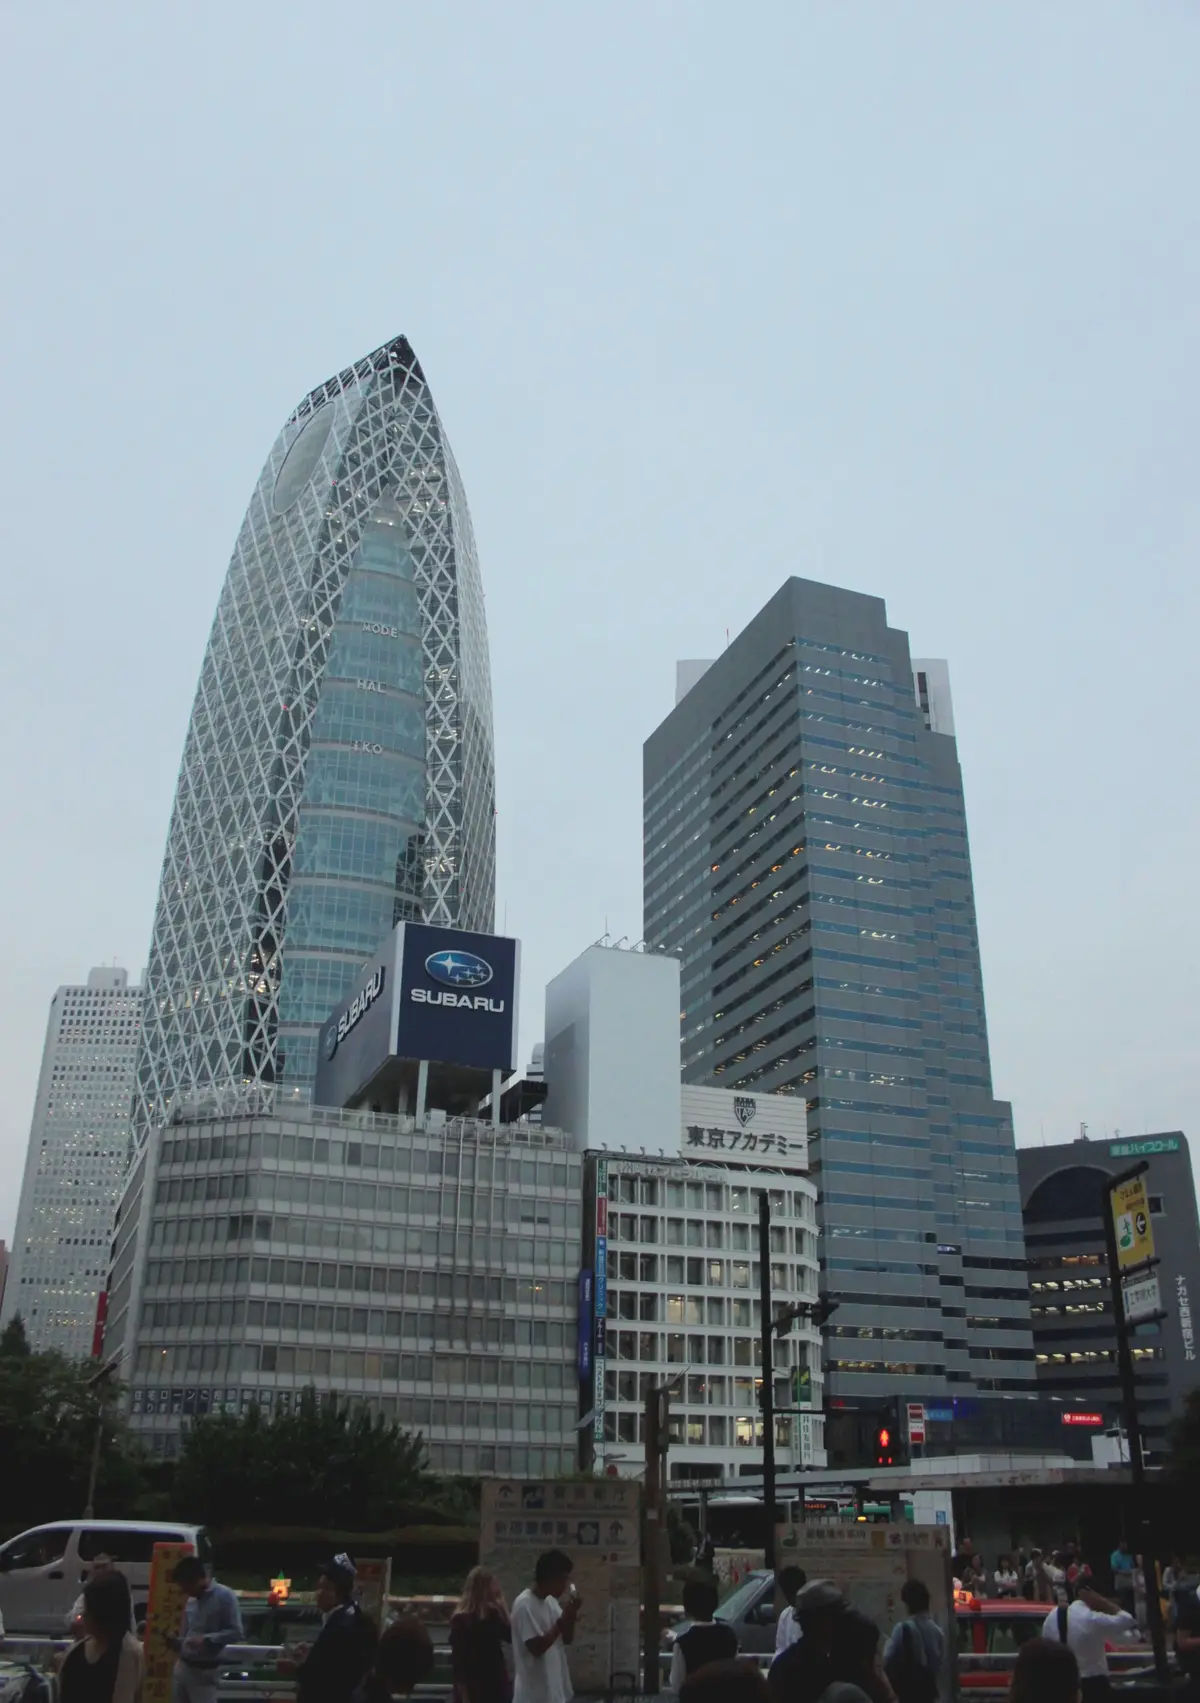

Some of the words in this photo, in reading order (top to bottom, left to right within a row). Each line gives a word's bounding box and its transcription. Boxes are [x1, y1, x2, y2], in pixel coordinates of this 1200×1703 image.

[337, 967, 383, 1041] SUBARU
[411, 988, 504, 1013] SUBARU
[686, 1125, 803, 1155] 東京アカデミー
